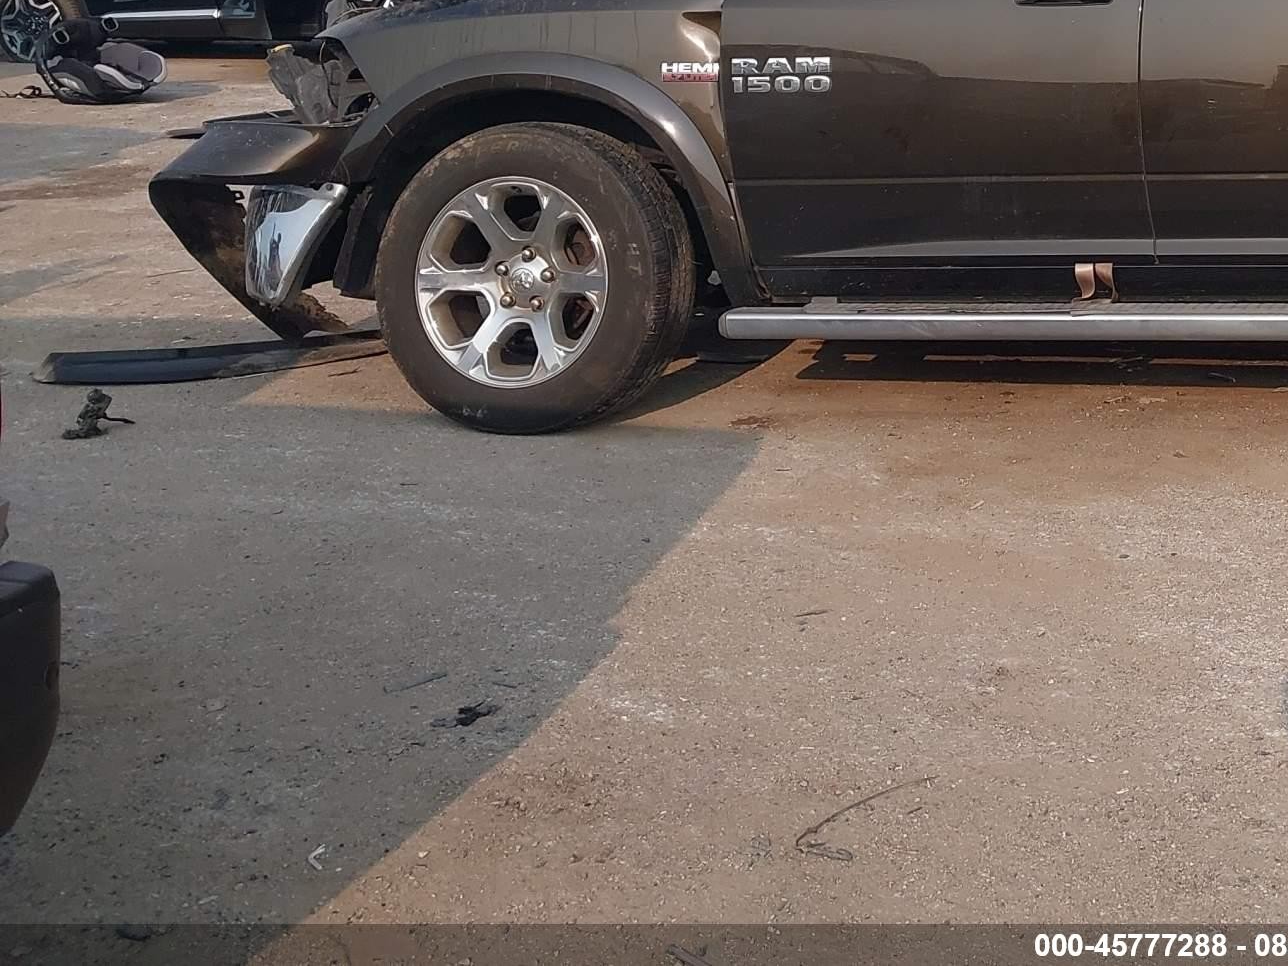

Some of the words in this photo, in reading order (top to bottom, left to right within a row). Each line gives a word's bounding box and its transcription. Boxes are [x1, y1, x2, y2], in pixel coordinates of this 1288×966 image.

[661, 62, 719, 73] HEMI
[731, 57, 831, 74] RAM
[731, 76, 832, 94] 1500
